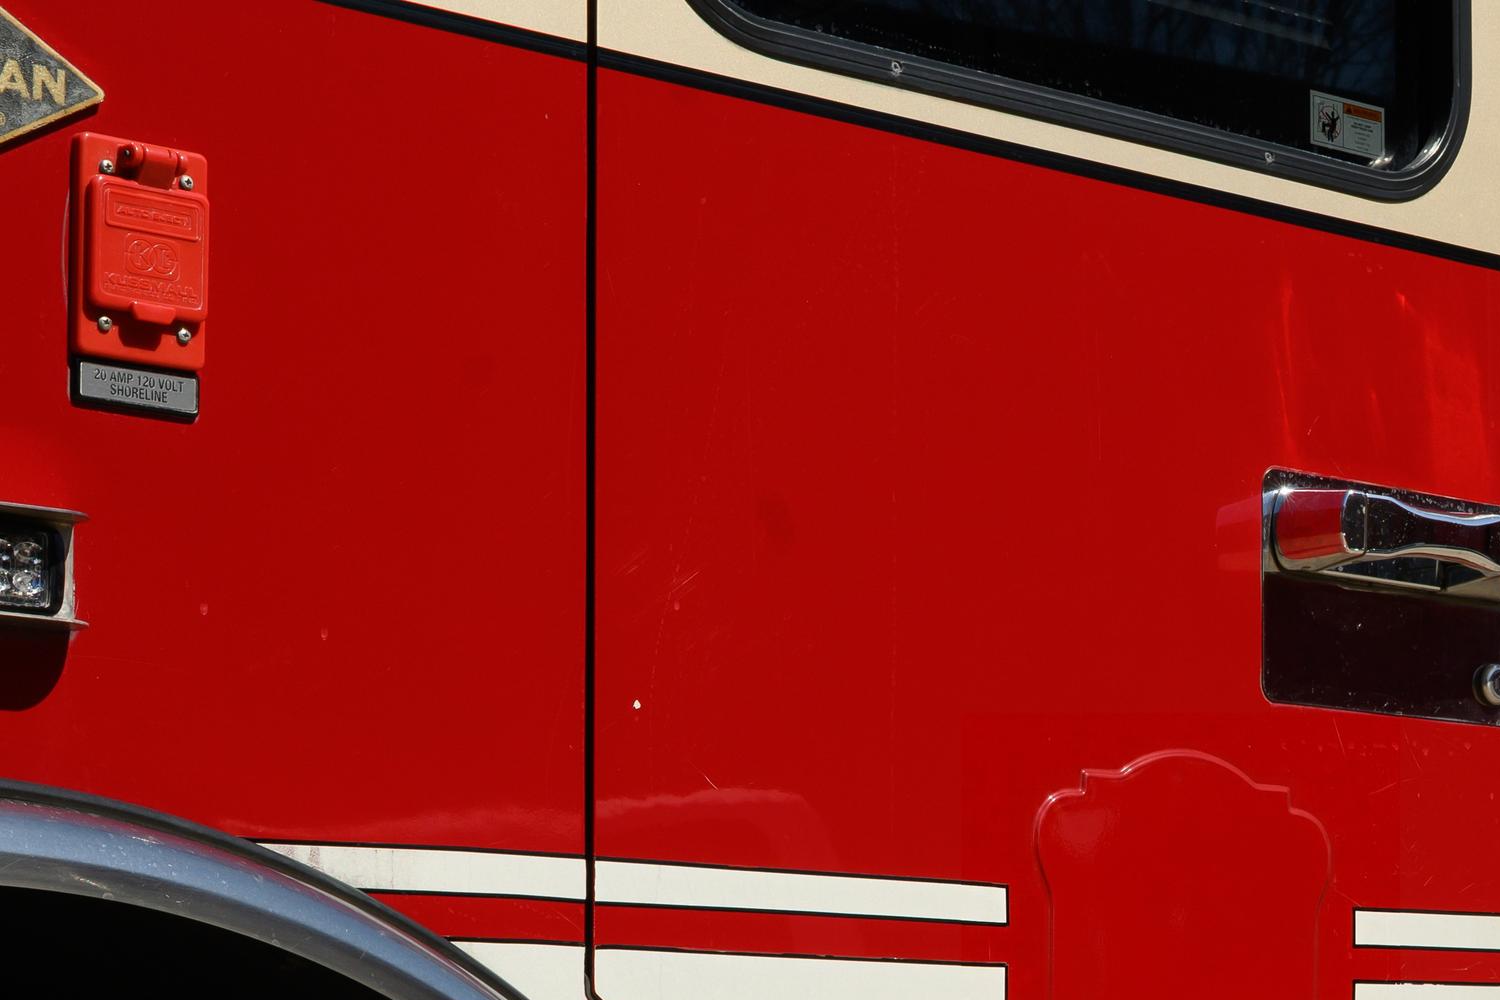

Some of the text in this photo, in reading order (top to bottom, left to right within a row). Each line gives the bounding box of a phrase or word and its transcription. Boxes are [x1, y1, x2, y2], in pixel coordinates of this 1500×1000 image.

[94, 368, 185, 394] 20 AMP 120 VOLT
[110, 384, 168, 404] SHORELINE
